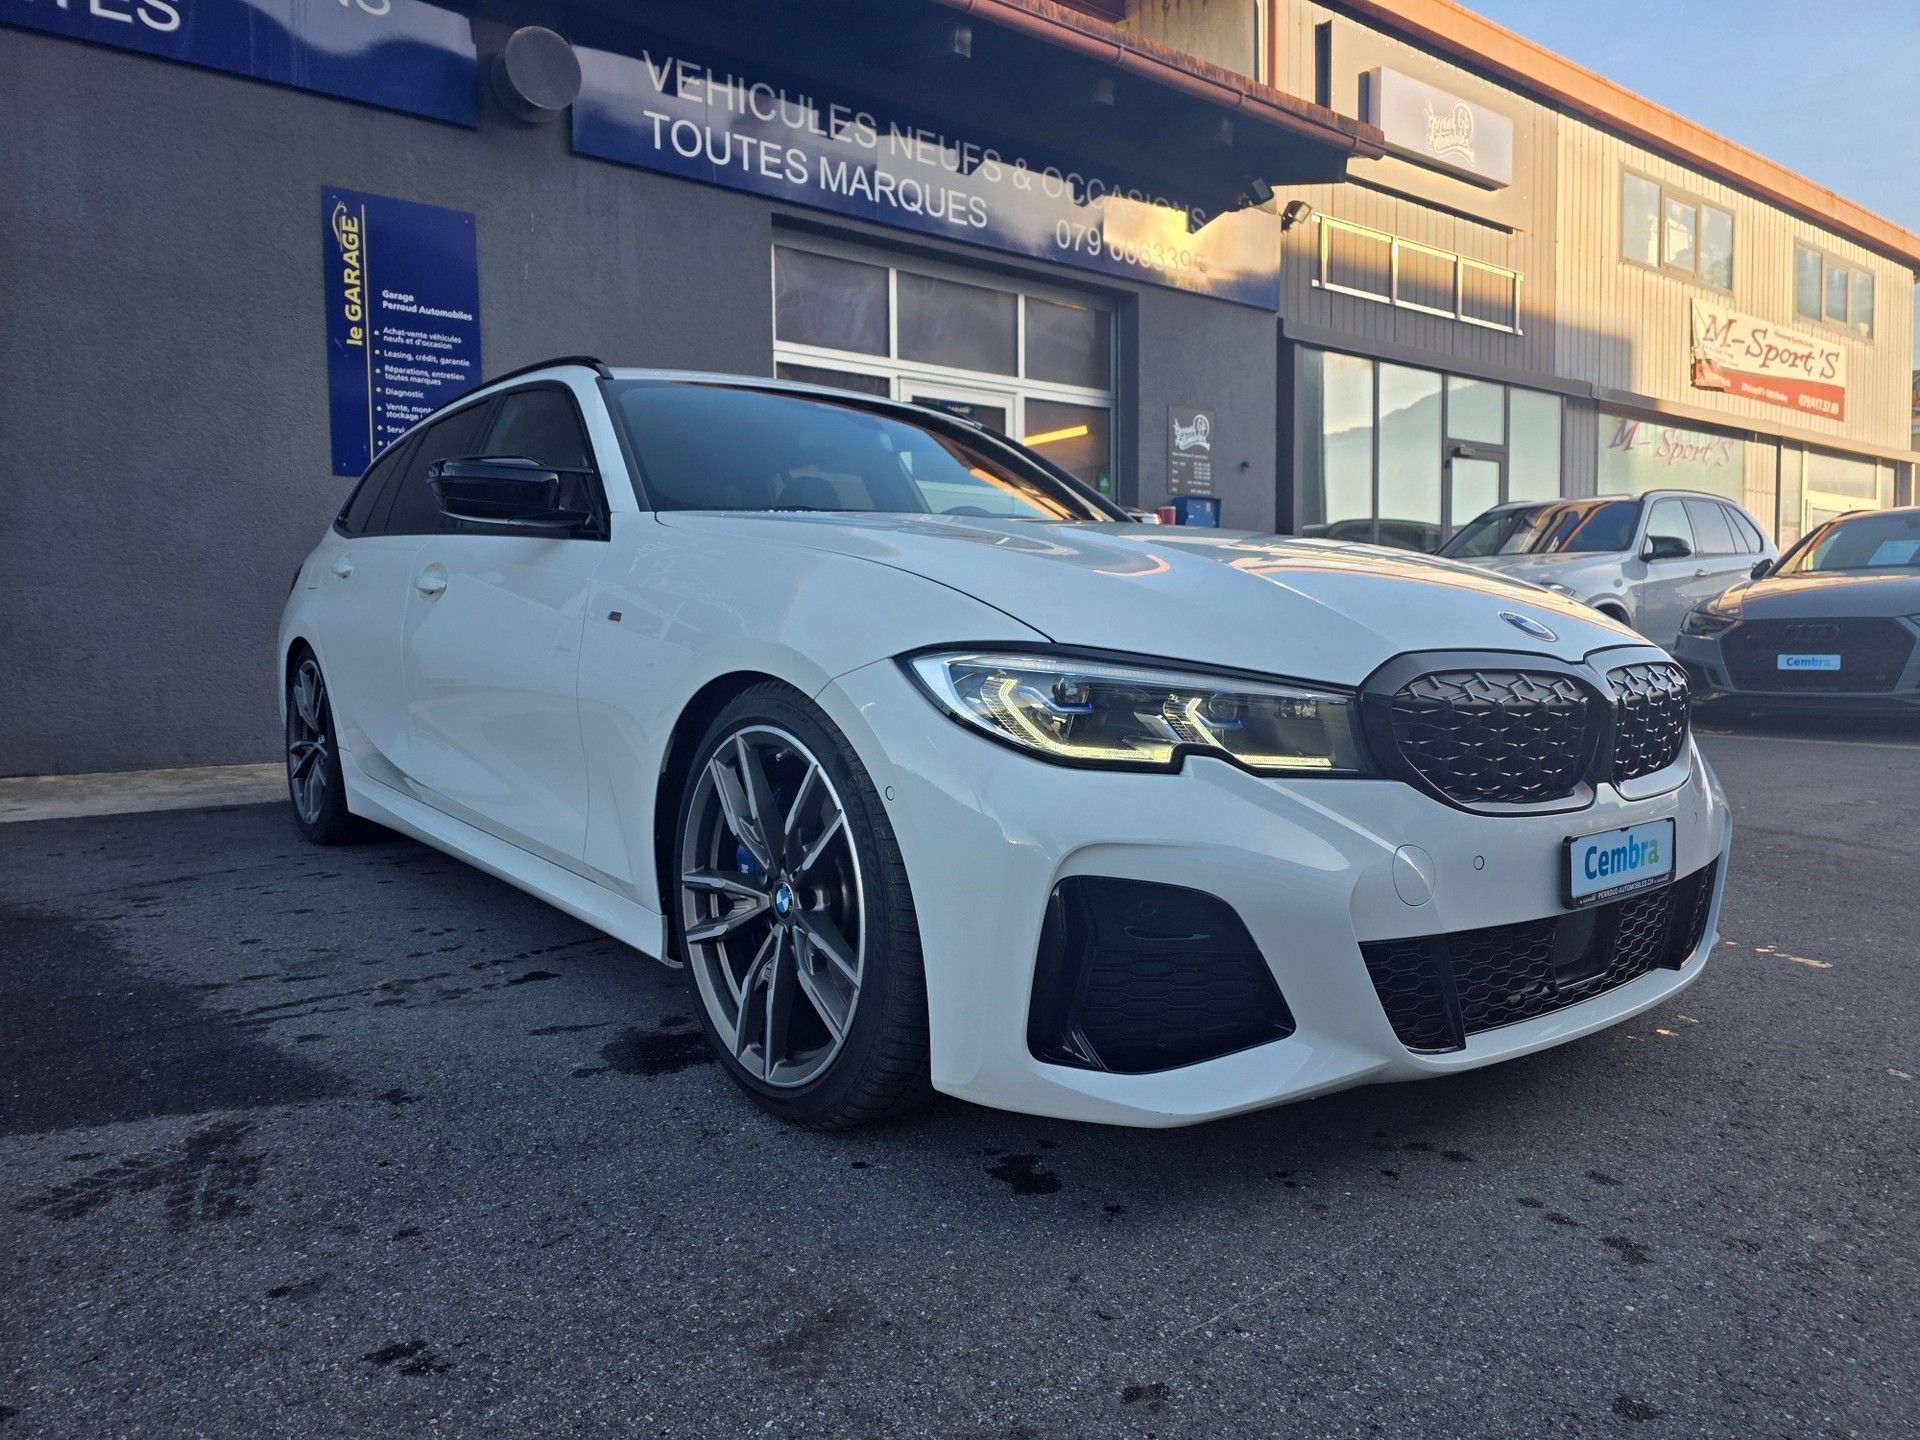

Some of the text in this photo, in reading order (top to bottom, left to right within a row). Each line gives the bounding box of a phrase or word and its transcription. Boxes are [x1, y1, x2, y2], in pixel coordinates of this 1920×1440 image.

[643, 49, 1207, 235] VEHICULES NEUFS & OCCANS
[643, 109, 988, 228] TOUTES MARQUES
[1056, 219, 1102, 256] 079
[341, 215, 363, 346] le GARAGE
[382, 289, 414, 303] Garage
[382, 300, 473, 321] Perroud Automobiles
[383, 326, 462, 344] Achat-vente véhicules
[383, 335, 404, 344] neufs
[439, 357, 470, 367] garantie
[384, 364, 465, 381] Réparations, entretien
[384, 373, 441, 386] toutes marques
[385, 387, 424, 398] Diagnostic
[386, 410, 419, 421] stockage
[1786, 656, 1831, 667] Cembra
[1584, 834, 1660, 880] Cembra
